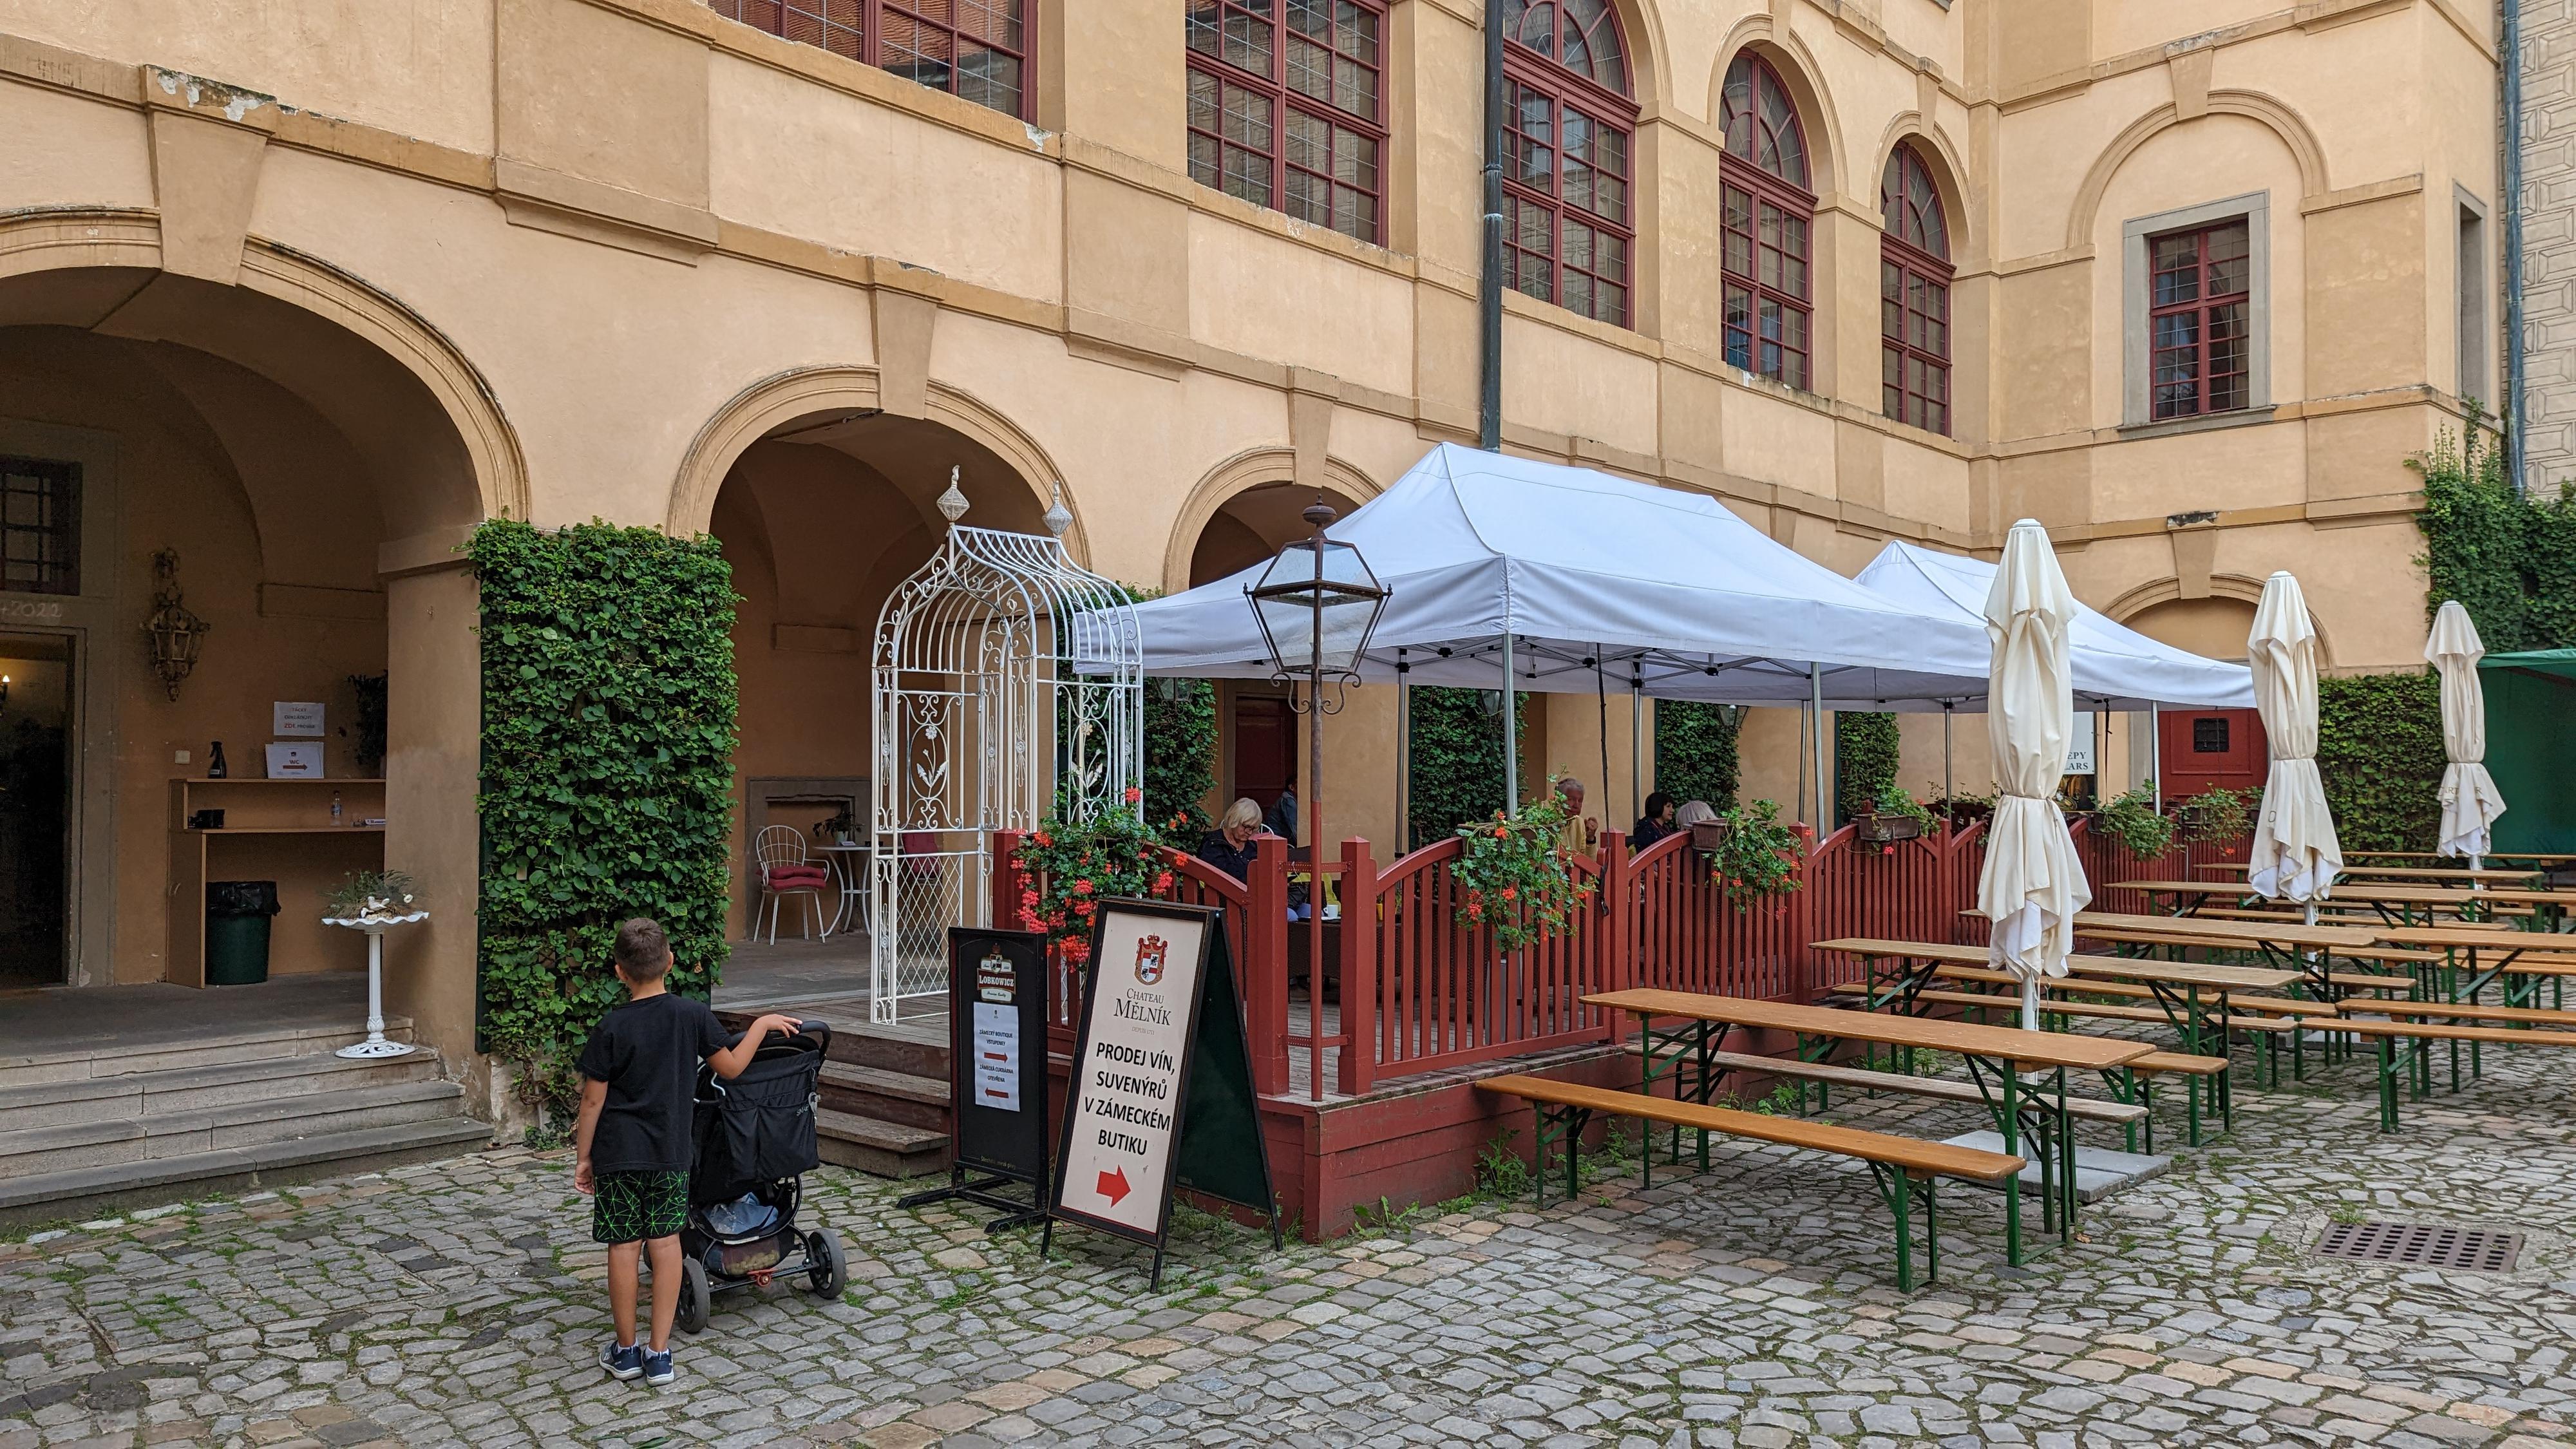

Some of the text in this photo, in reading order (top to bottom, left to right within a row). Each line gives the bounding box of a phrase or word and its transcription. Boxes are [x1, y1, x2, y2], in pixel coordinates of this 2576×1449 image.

[979, 975, 1014, 987] LOBKOWICZ
[1126, 988, 1164, 1005] CHATEAU
[1113, 998, 1172, 1026] MĚLNÍK
[1096, 1042, 1175, 1075] PRODEJ VÍN,
[1096, 1070, 1167, 1100] SUVENÝRŮ
[1085, 1096, 1171, 1132] V ZÁMECKÉM
[1098, 1129, 1148, 1155] BUTIKU
